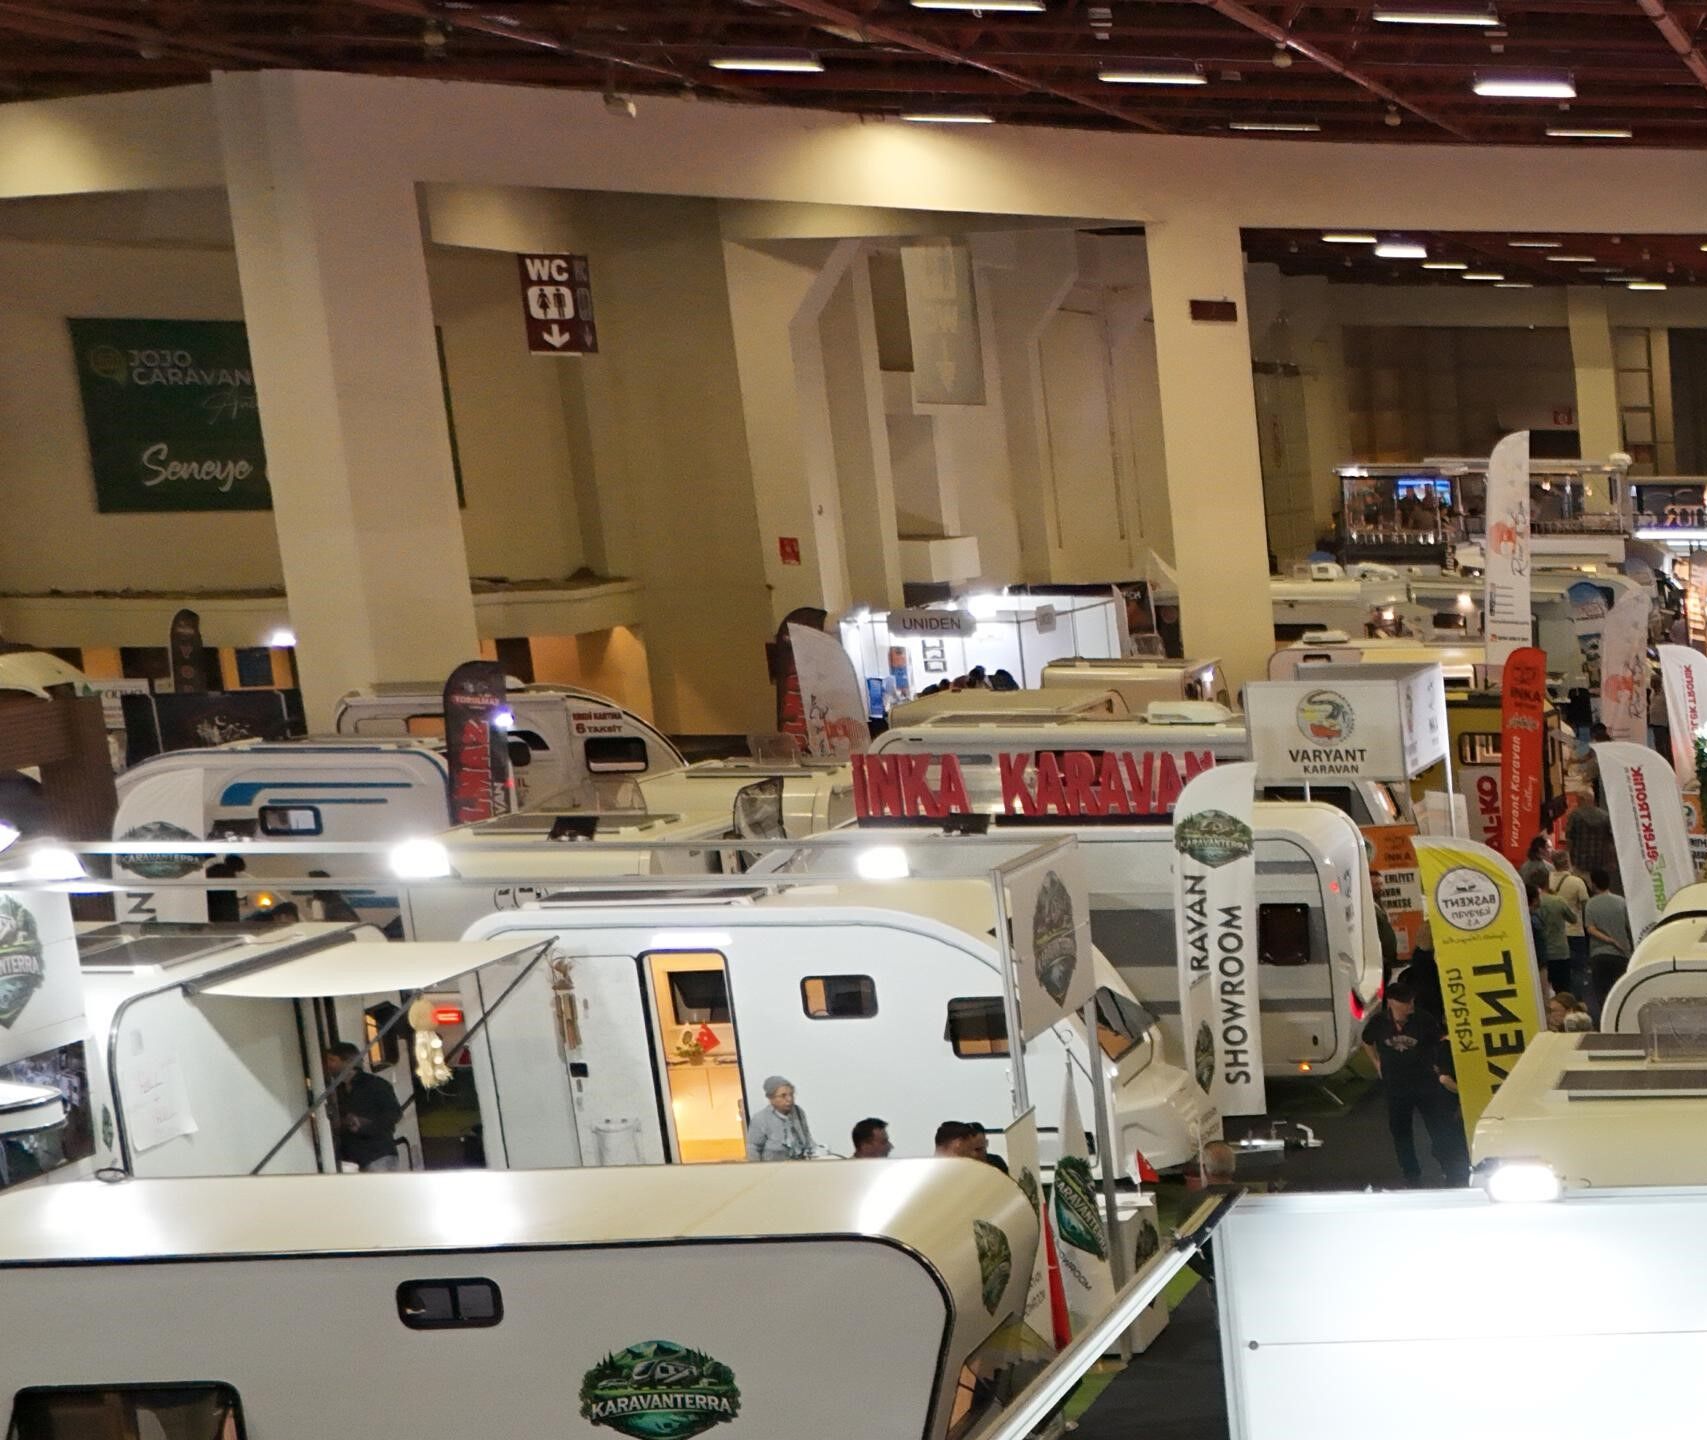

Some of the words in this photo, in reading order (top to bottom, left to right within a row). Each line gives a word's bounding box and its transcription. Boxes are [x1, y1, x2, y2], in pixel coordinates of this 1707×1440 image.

[524, 258, 569, 282] WC
[142, 441, 255, 492] Seneye
[902, 615, 962, 631] UNIDEN
[575, 722, 586, 734] 6
[1288, 749, 1367, 763] VARYANT
[1303, 764, 1360, 774] KARAVAN
[852, 752, 973, 817] INKA
[1217, 904, 1252, 1086] SHOWROOM
[591, 1392, 733, 1419] KARAVANTERRA
